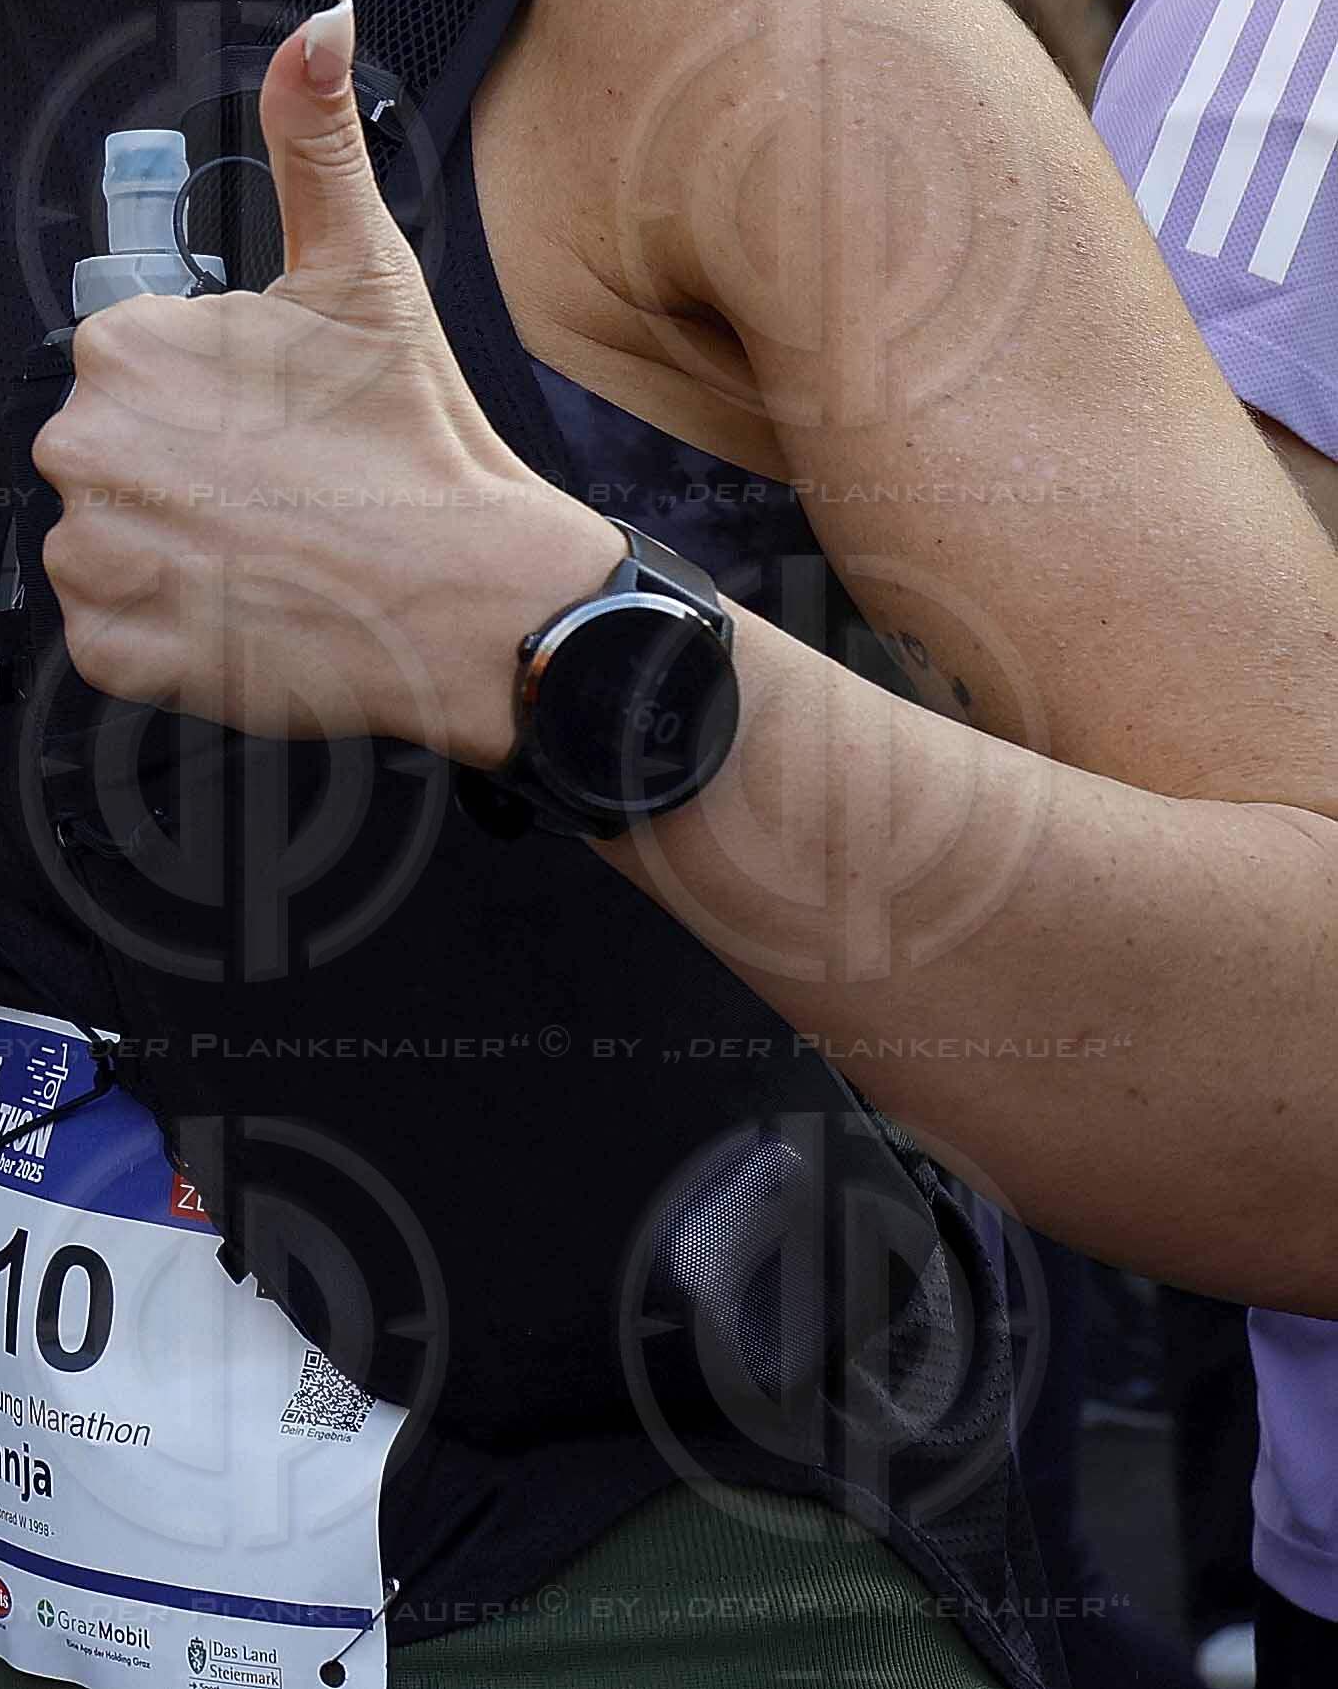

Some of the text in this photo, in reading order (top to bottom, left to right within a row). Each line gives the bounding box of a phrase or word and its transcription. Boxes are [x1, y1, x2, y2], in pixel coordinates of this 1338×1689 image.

[14, 1158, 45, 1183] 2025
[29, 1395, 151, 1447] Marathon
[280, 1425, 352, 1443] Dein Ergebnis
[213, 1640, 278, 1664] Das Land
[209, 1663, 280, 1687] Steiermark
